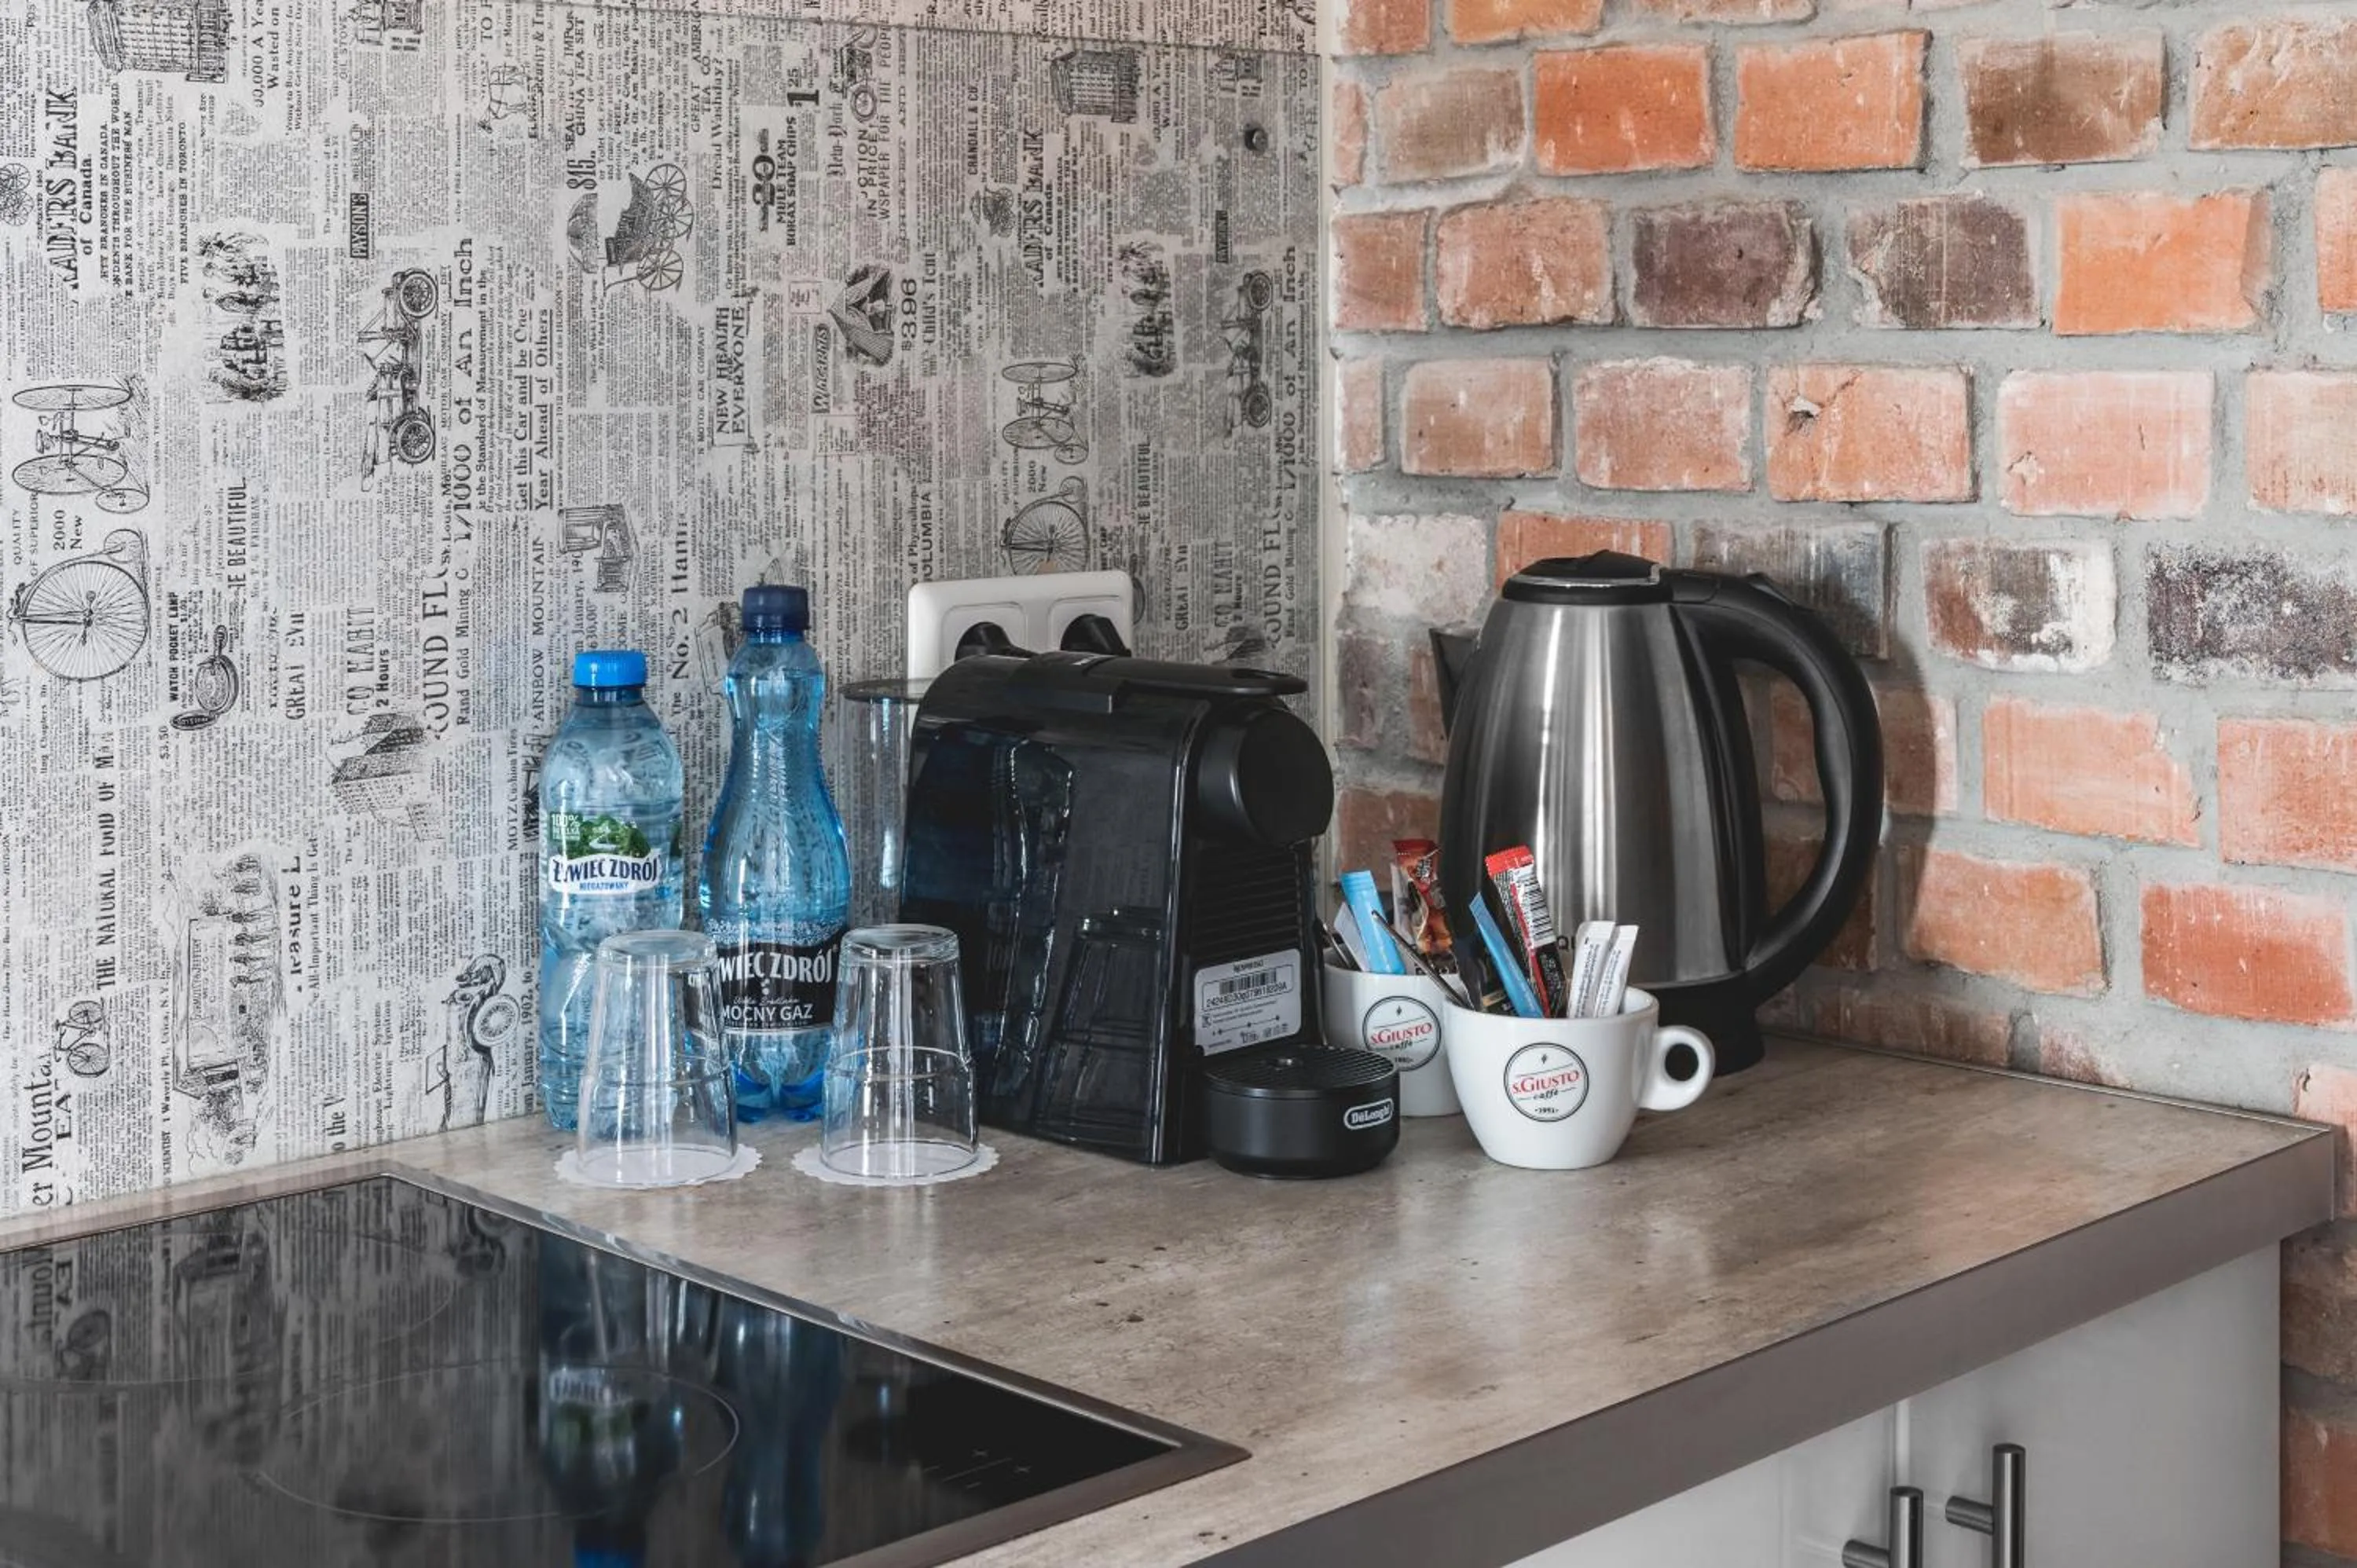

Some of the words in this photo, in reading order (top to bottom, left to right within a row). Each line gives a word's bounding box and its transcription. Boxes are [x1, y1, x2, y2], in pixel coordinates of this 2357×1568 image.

[271, 7, 279, 26] on
[574, 18, 585, 44] SET
[251, 37, 264, 47] A
[267, 31, 279, 89] Wasted
[574, 51, 585, 78] TEA
[575, 89, 585, 136] CHINA
[691, 82, 700, 133] GREAT
[702, 86, 711, 113] TEA
[711, 57, 724, 137] Washday?
[45, 86, 78, 170] BANK
[786, 115, 797, 157] CHIPS
[878, 115, 891, 141] FOR
[178, 122, 187, 173] TORONTO
[776, 139, 786, 178] TEAM
[967, 120, 979, 175] CRANDALL
[179, 178, 188, 189] IN
[711, 144, 722, 190] Dread
[752, 155, 775, 206] 20
[786, 162, 797, 196] SOAP
[112, 155, 120, 233] THROUGHOUT
[776, 185, 786, 224] MULE
[867, 200, 878, 218] IN
[124, 225, 133, 248] FOR
[179, 194, 189, 251] BRANCHES
[352, 194, 367, 255] PAYSON'S
[786, 200, 797, 246] BORAX
[80, 239, 92, 255] of
[1045, 247, 1054, 260] of
[180, 258, 189, 284] FIVE
[453, 238, 472, 308] Inch
[476, 270, 486, 288] the
[922, 253, 936, 284] Tent
[1282, 247, 1296, 302] Inch
[476, 294, 486, 305] in
[900, 279, 917, 350] $3.96
[922, 294, 936, 343] Child's
[454, 328, 471, 377] An
[476, 310, 486, 394] Measurement
[534, 310, 549, 367] Others
[716, 307, 730, 379] HEALTH
[1284, 321, 1296, 357] An
[513, 350, 528, 368] be
[732, 306, 745, 434] EVERYONE
[476, 397, 486, 409] of
[513, 375, 528, 404] and
[534, 377, 549, 393] of
[453, 397, 472, 424] of
[513, 411, 528, 441] Car
[717, 389, 730, 434] NEW
[476, 415, 486, 471] Standard
[534, 404, 549, 459] Ahead
[513, 447, 528, 475] this
[453, 445, 473, 543] 1/1000
[476, 476, 486, 496] the
[535, 470, 549, 510] Year
[12, 509, 22, 565] QUALITY
[53, 510, 65, 550] 2000
[69, 515, 82, 550] New
[441, 500, 452, 540] Louis,
[168, 592, 178, 618] LAMP
[455, 588, 472, 637] Mining
[673, 607, 688, 625] 2
[168, 624, 178, 661] POCKET
[672, 636, 689, 680] No.
[376, 648, 389, 691] Hours
[455, 648, 470, 679] Gold
[168, 666, 178, 702] WATCH
[376, 698, 389, 707] 2
[455, 689, 470, 725] Rand
[672, 693, 681, 716] The
[159, 725, 170, 760] $3.50
[508, 758, 519, 801] Cushion
[508, 804, 519, 851] MOTZ
[609, 856, 658, 882] ZDRÓJ
[307, 876, 320, 907] Thing
[96, 956, 115, 990] THE
[522, 971, 533, 984] to
[718, 951, 766, 983] WIEC
[768, 948, 834, 984] ZDRÓJ
[372, 1002, 383, 1045] Systems
[521, 989, 534, 1025] 1902,
[721, 1004, 777, 1021] MOCNY
[779, 1003, 814, 1020] GAZ
[372, 1052, 383, 1093] Electric
[521, 1031, 535, 1087] January,
[161, 1072, 170, 1113] Waverly
[323, 1112, 346, 1136] the
